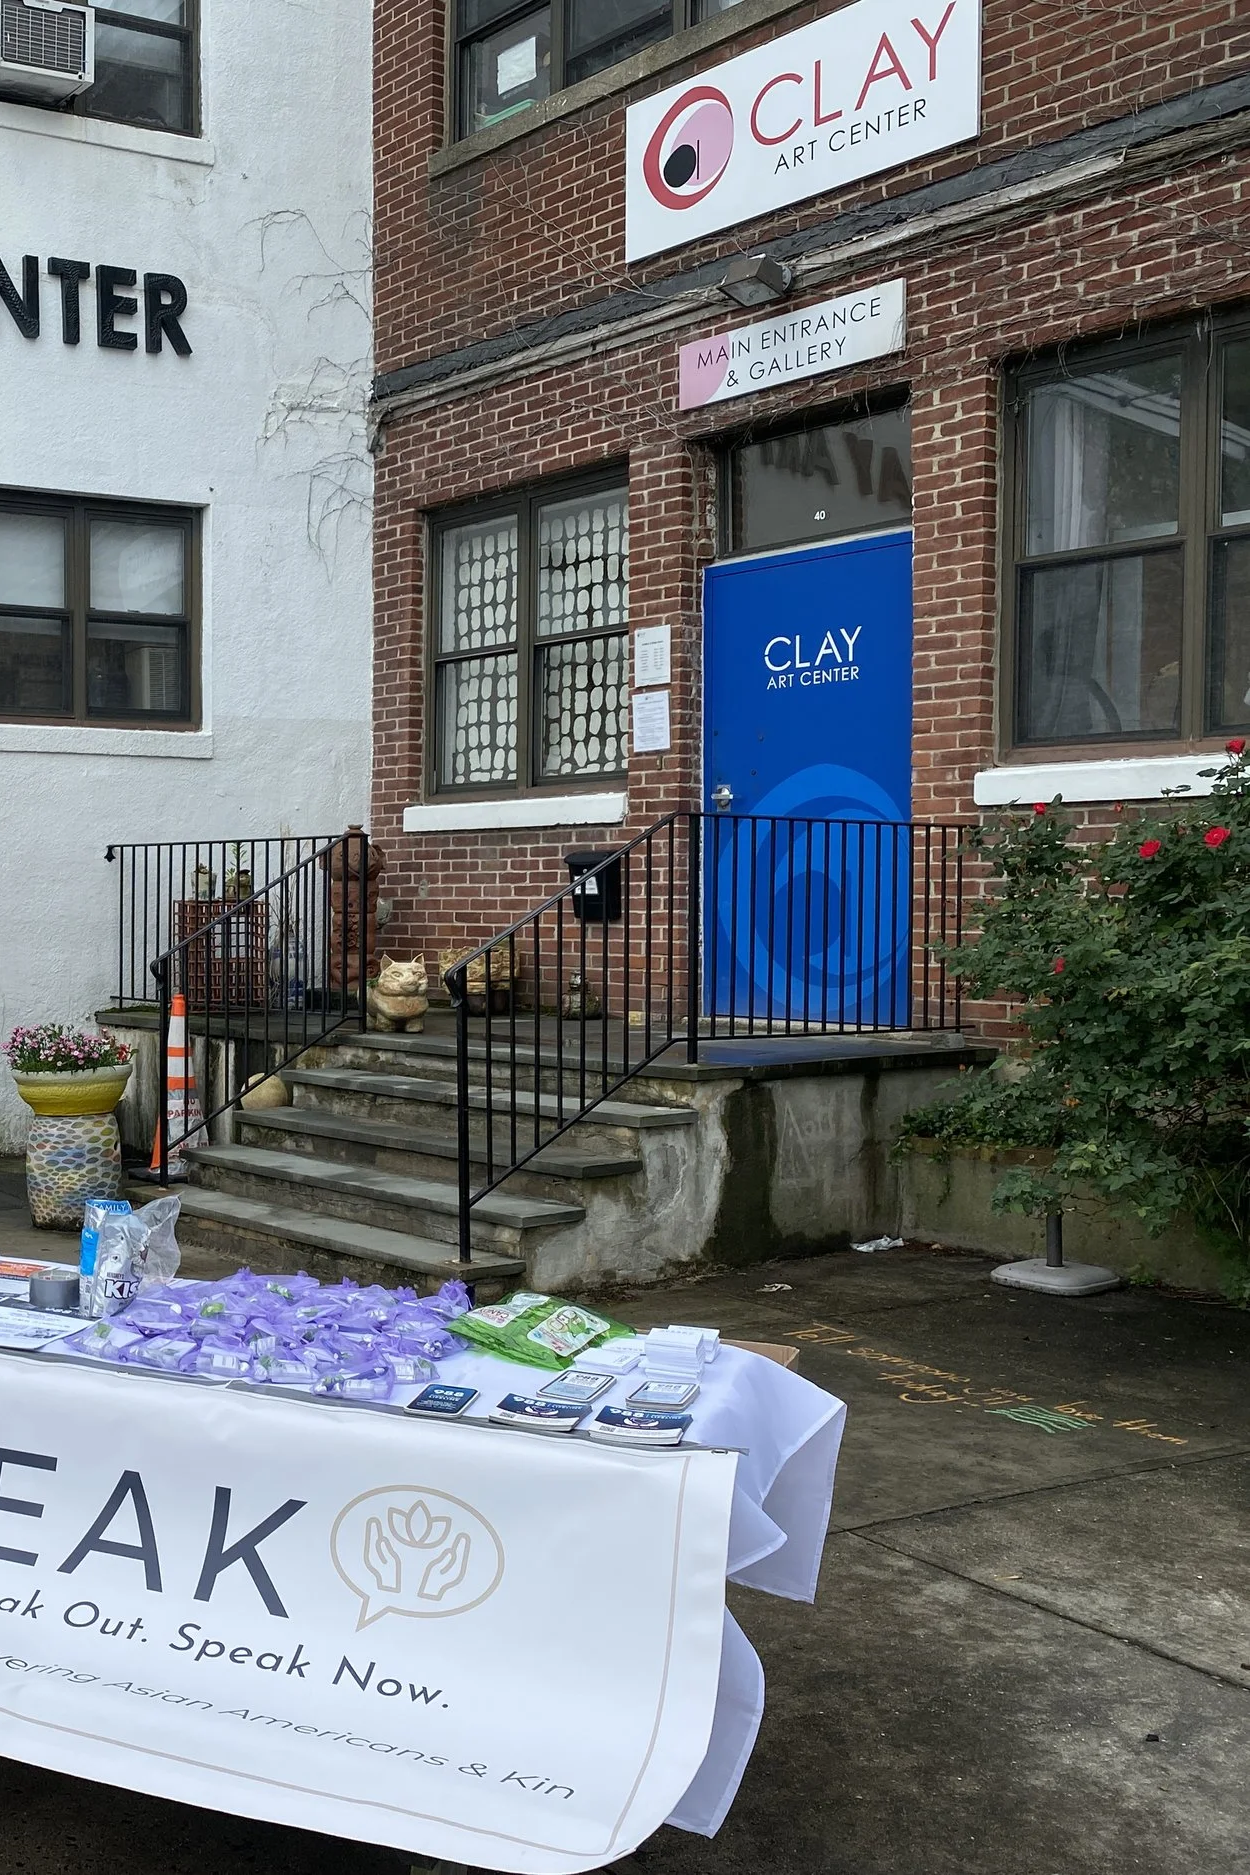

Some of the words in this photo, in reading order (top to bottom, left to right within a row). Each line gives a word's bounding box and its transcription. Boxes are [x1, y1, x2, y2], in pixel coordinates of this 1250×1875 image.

[750, 2, 956, 145] CLAY
[774, 140, 818, 175] ART
[828, 98, 926, 152] CENTER
[697, 337, 751, 369] MAIN
[761, 296, 881, 350] ENTRANCE
[726, 370, 739, 387] &
[749, 336, 847, 380] GALLERY
[814, 510, 826, 521] 40
[764, 626, 862, 672] CLAY
[766, 673, 794, 690] ART
[800, 666, 859, 686] CENTER
[63, 1601, 148, 1643] Out.
[169, 1622, 312, 1678] Speak
[332, 1655, 450, 1709] Now.
[103, 1679, 227, 1711] Asian
[218, 1707, 449, 1767] Americans
[459, 1761, 489, 1779] &
[500, 1770, 577, 1800] Kin
